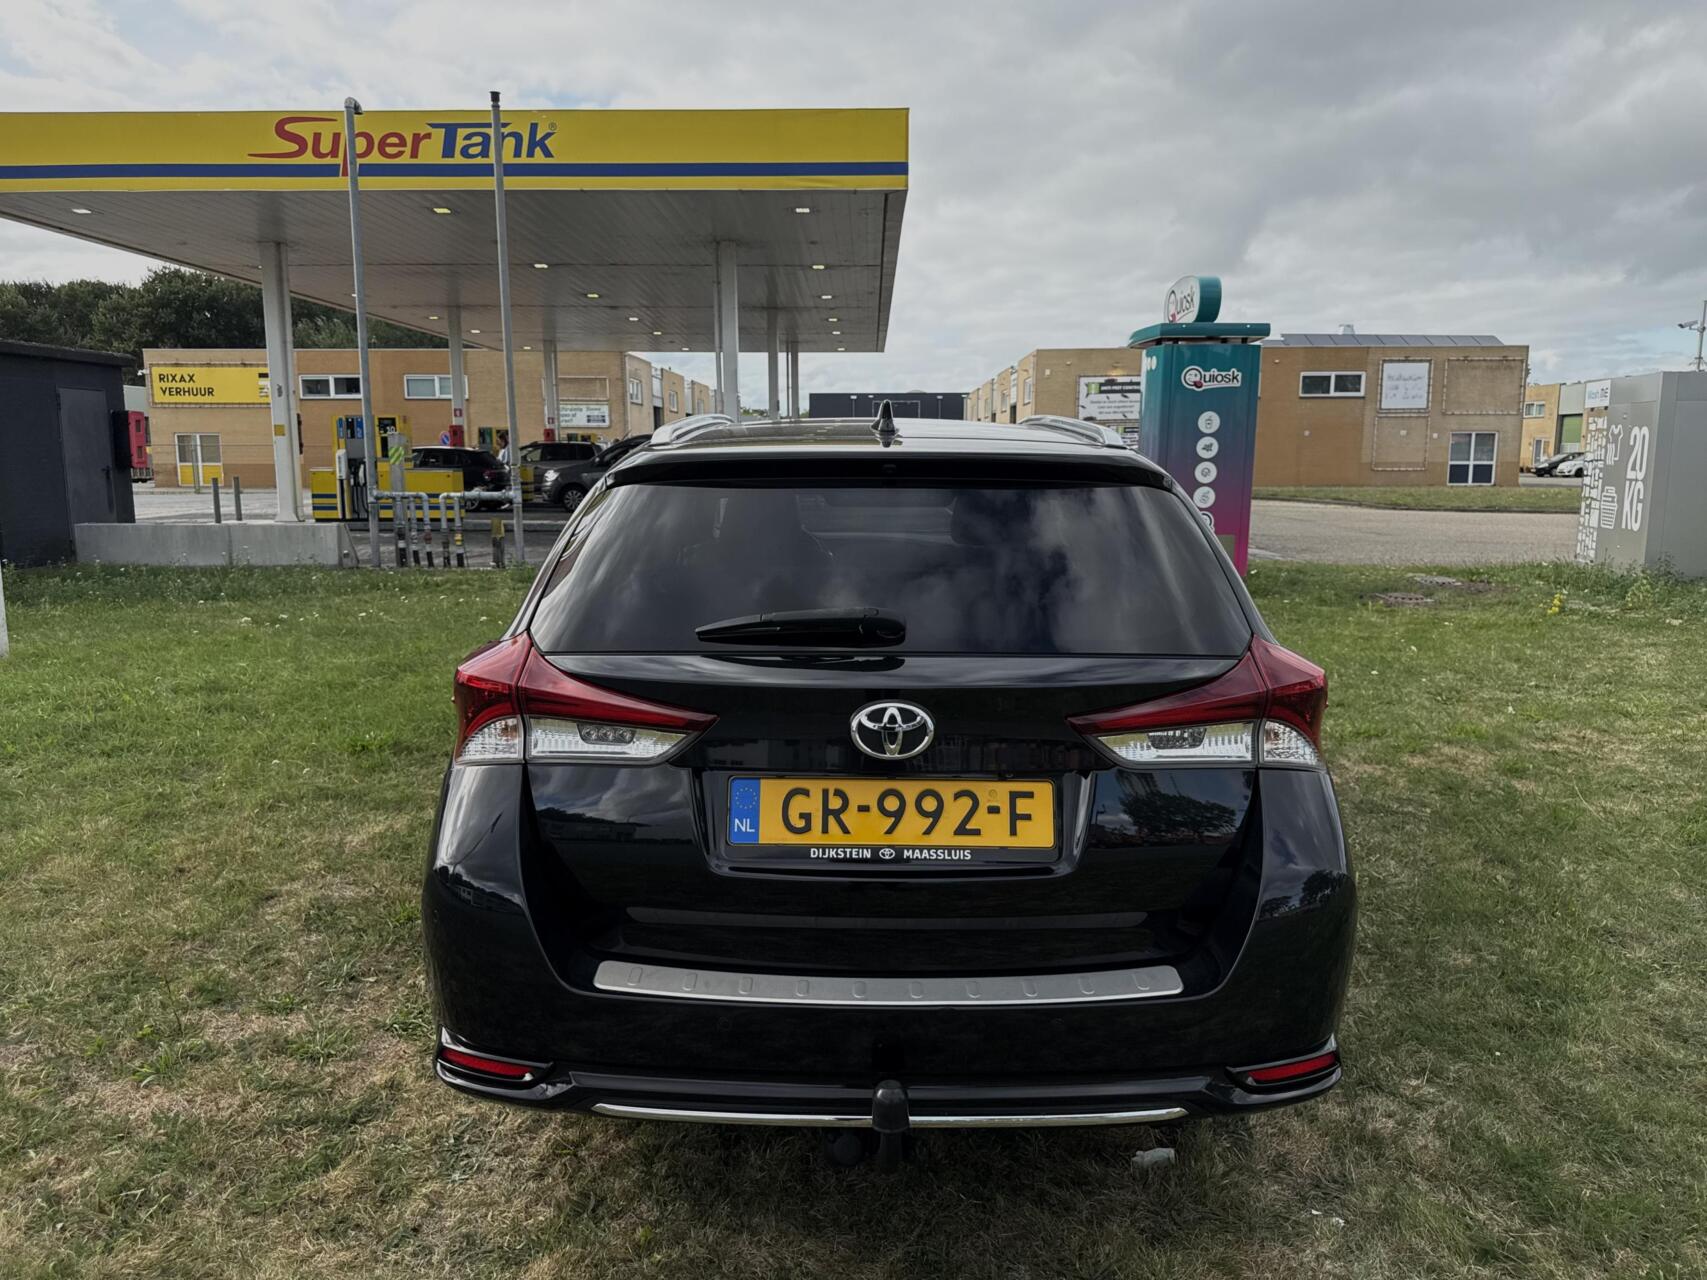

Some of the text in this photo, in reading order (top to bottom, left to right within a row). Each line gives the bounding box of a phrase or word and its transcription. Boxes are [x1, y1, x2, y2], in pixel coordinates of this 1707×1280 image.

[158, 373, 196, 383] RIXAX
[1183, 367, 1240, 389] Quiosk
[160, 387, 215, 397] VERHUUR
[1626, 426, 1649, 480] 20
[1621, 481, 1644, 532] KG
[734, 787, 1035, 837] NL GR-992-F
[810, 848, 971, 860] DIJKSTEIN MAASSLUIS
